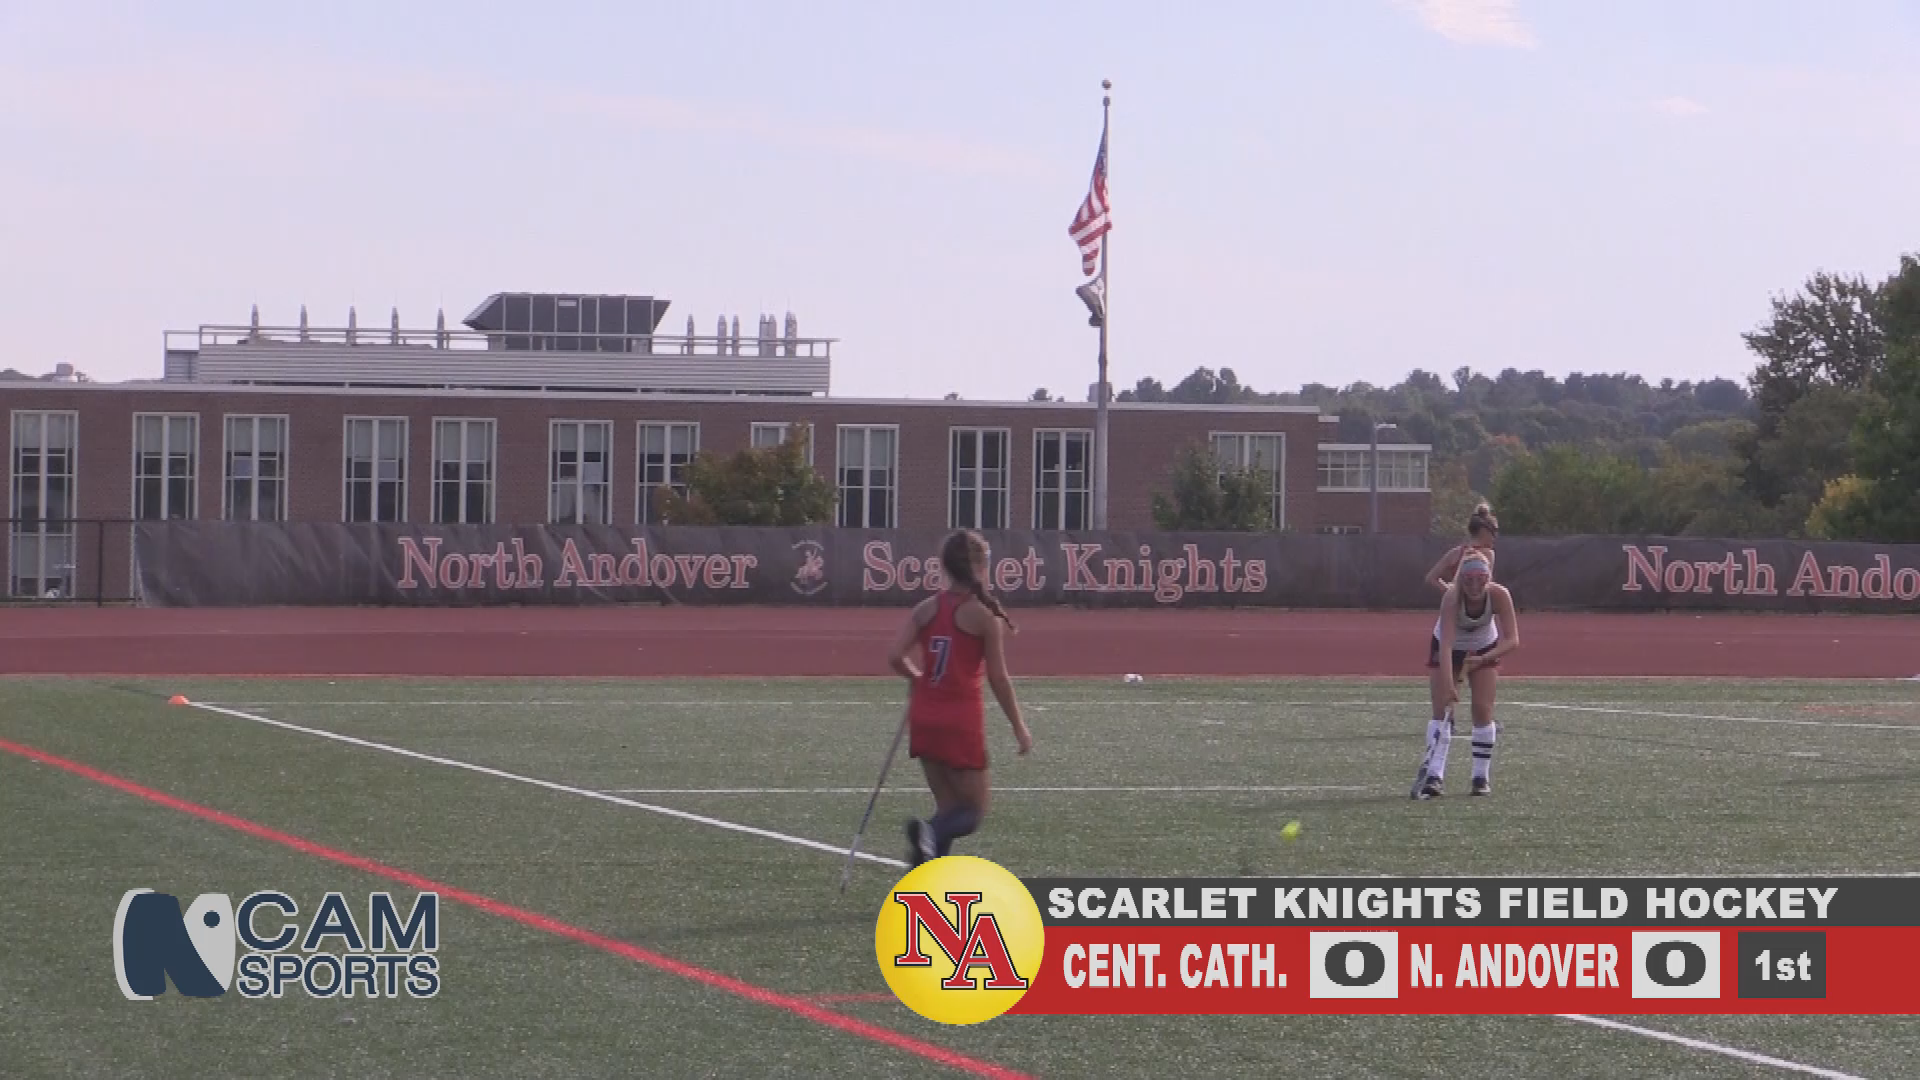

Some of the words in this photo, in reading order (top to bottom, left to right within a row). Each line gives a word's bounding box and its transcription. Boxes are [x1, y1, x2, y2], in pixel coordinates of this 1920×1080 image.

[398, 537, 544, 588] North
[554, 537, 757, 588] Andover
[863, 540, 1046, 591] Scaet
[1060, 543, 1267, 602] Knights
[1622, 544, 1778, 595] North
[1786, 550, 1920, 600] Ando
[929, 636, 952, 685] 7
